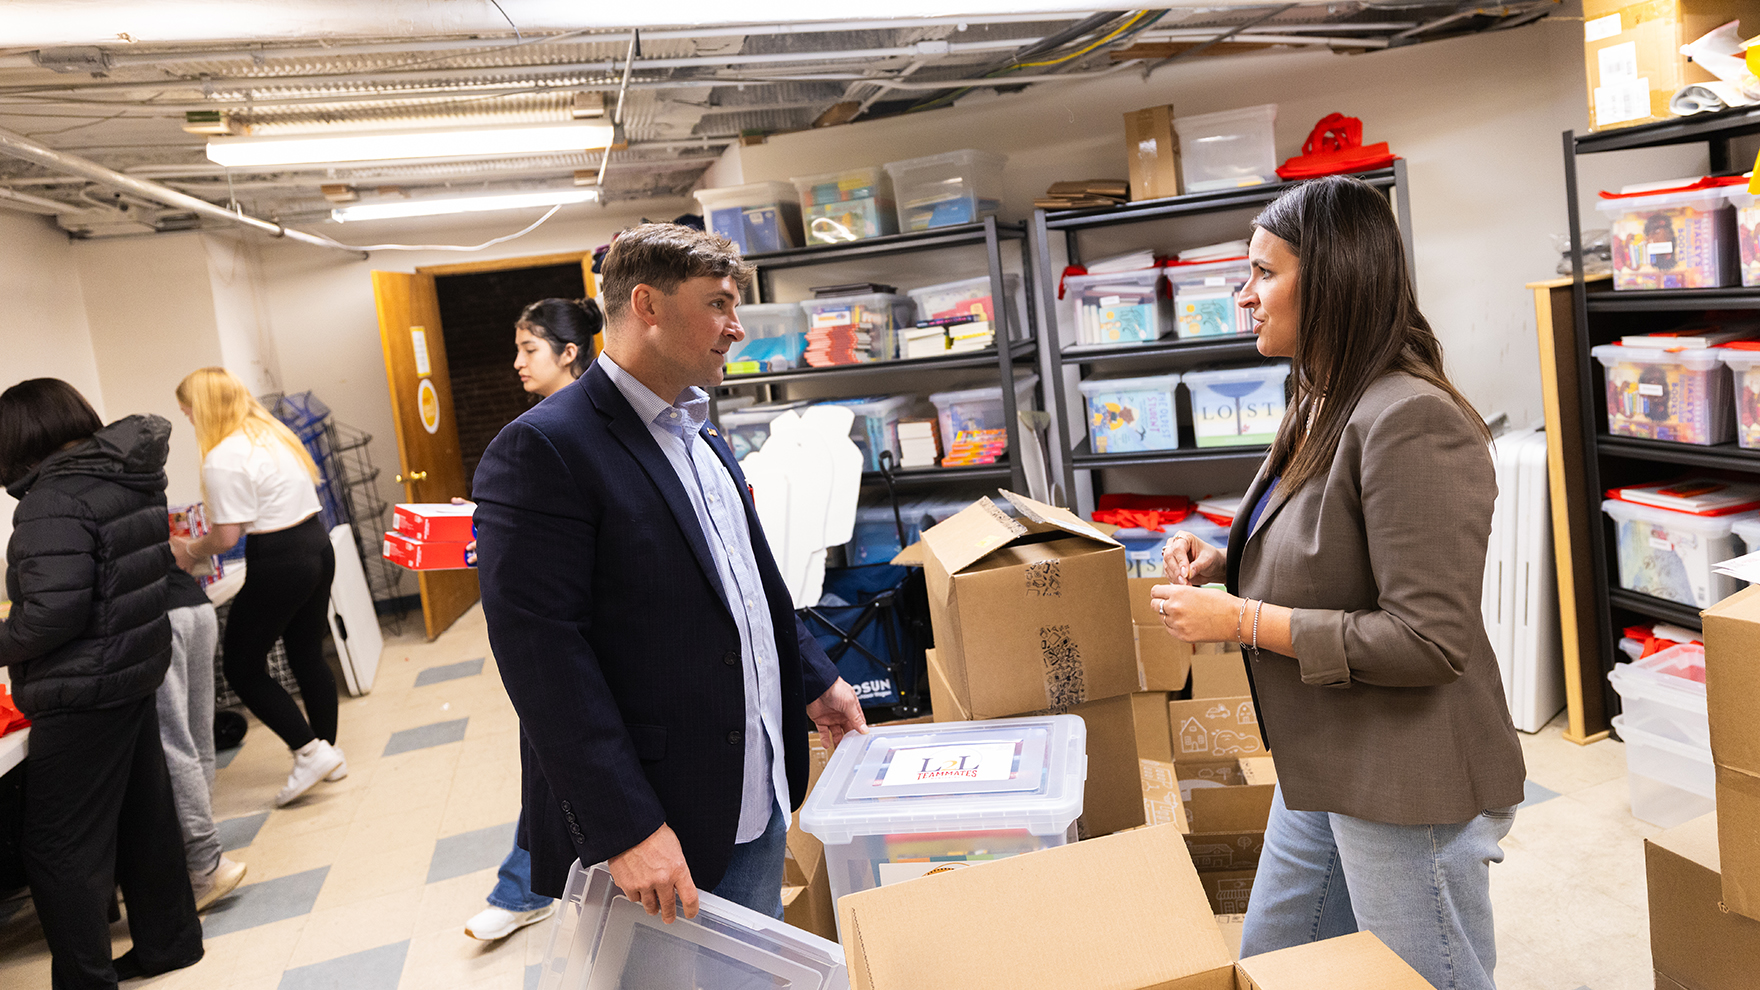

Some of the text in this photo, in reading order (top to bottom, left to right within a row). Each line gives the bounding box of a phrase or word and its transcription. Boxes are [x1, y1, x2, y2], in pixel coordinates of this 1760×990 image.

[1677, 228, 1686, 262] BOOKS
[1147, 396, 1160, 433] STUDENT
[1671, 382, 1679, 416] BOOKS
[1160, 408, 1172, 439] OLDEST
[852, 678, 892, 696] OSUN
[917, 769, 978, 780] TEAMMATES
[920, 755, 980, 772] L2L
